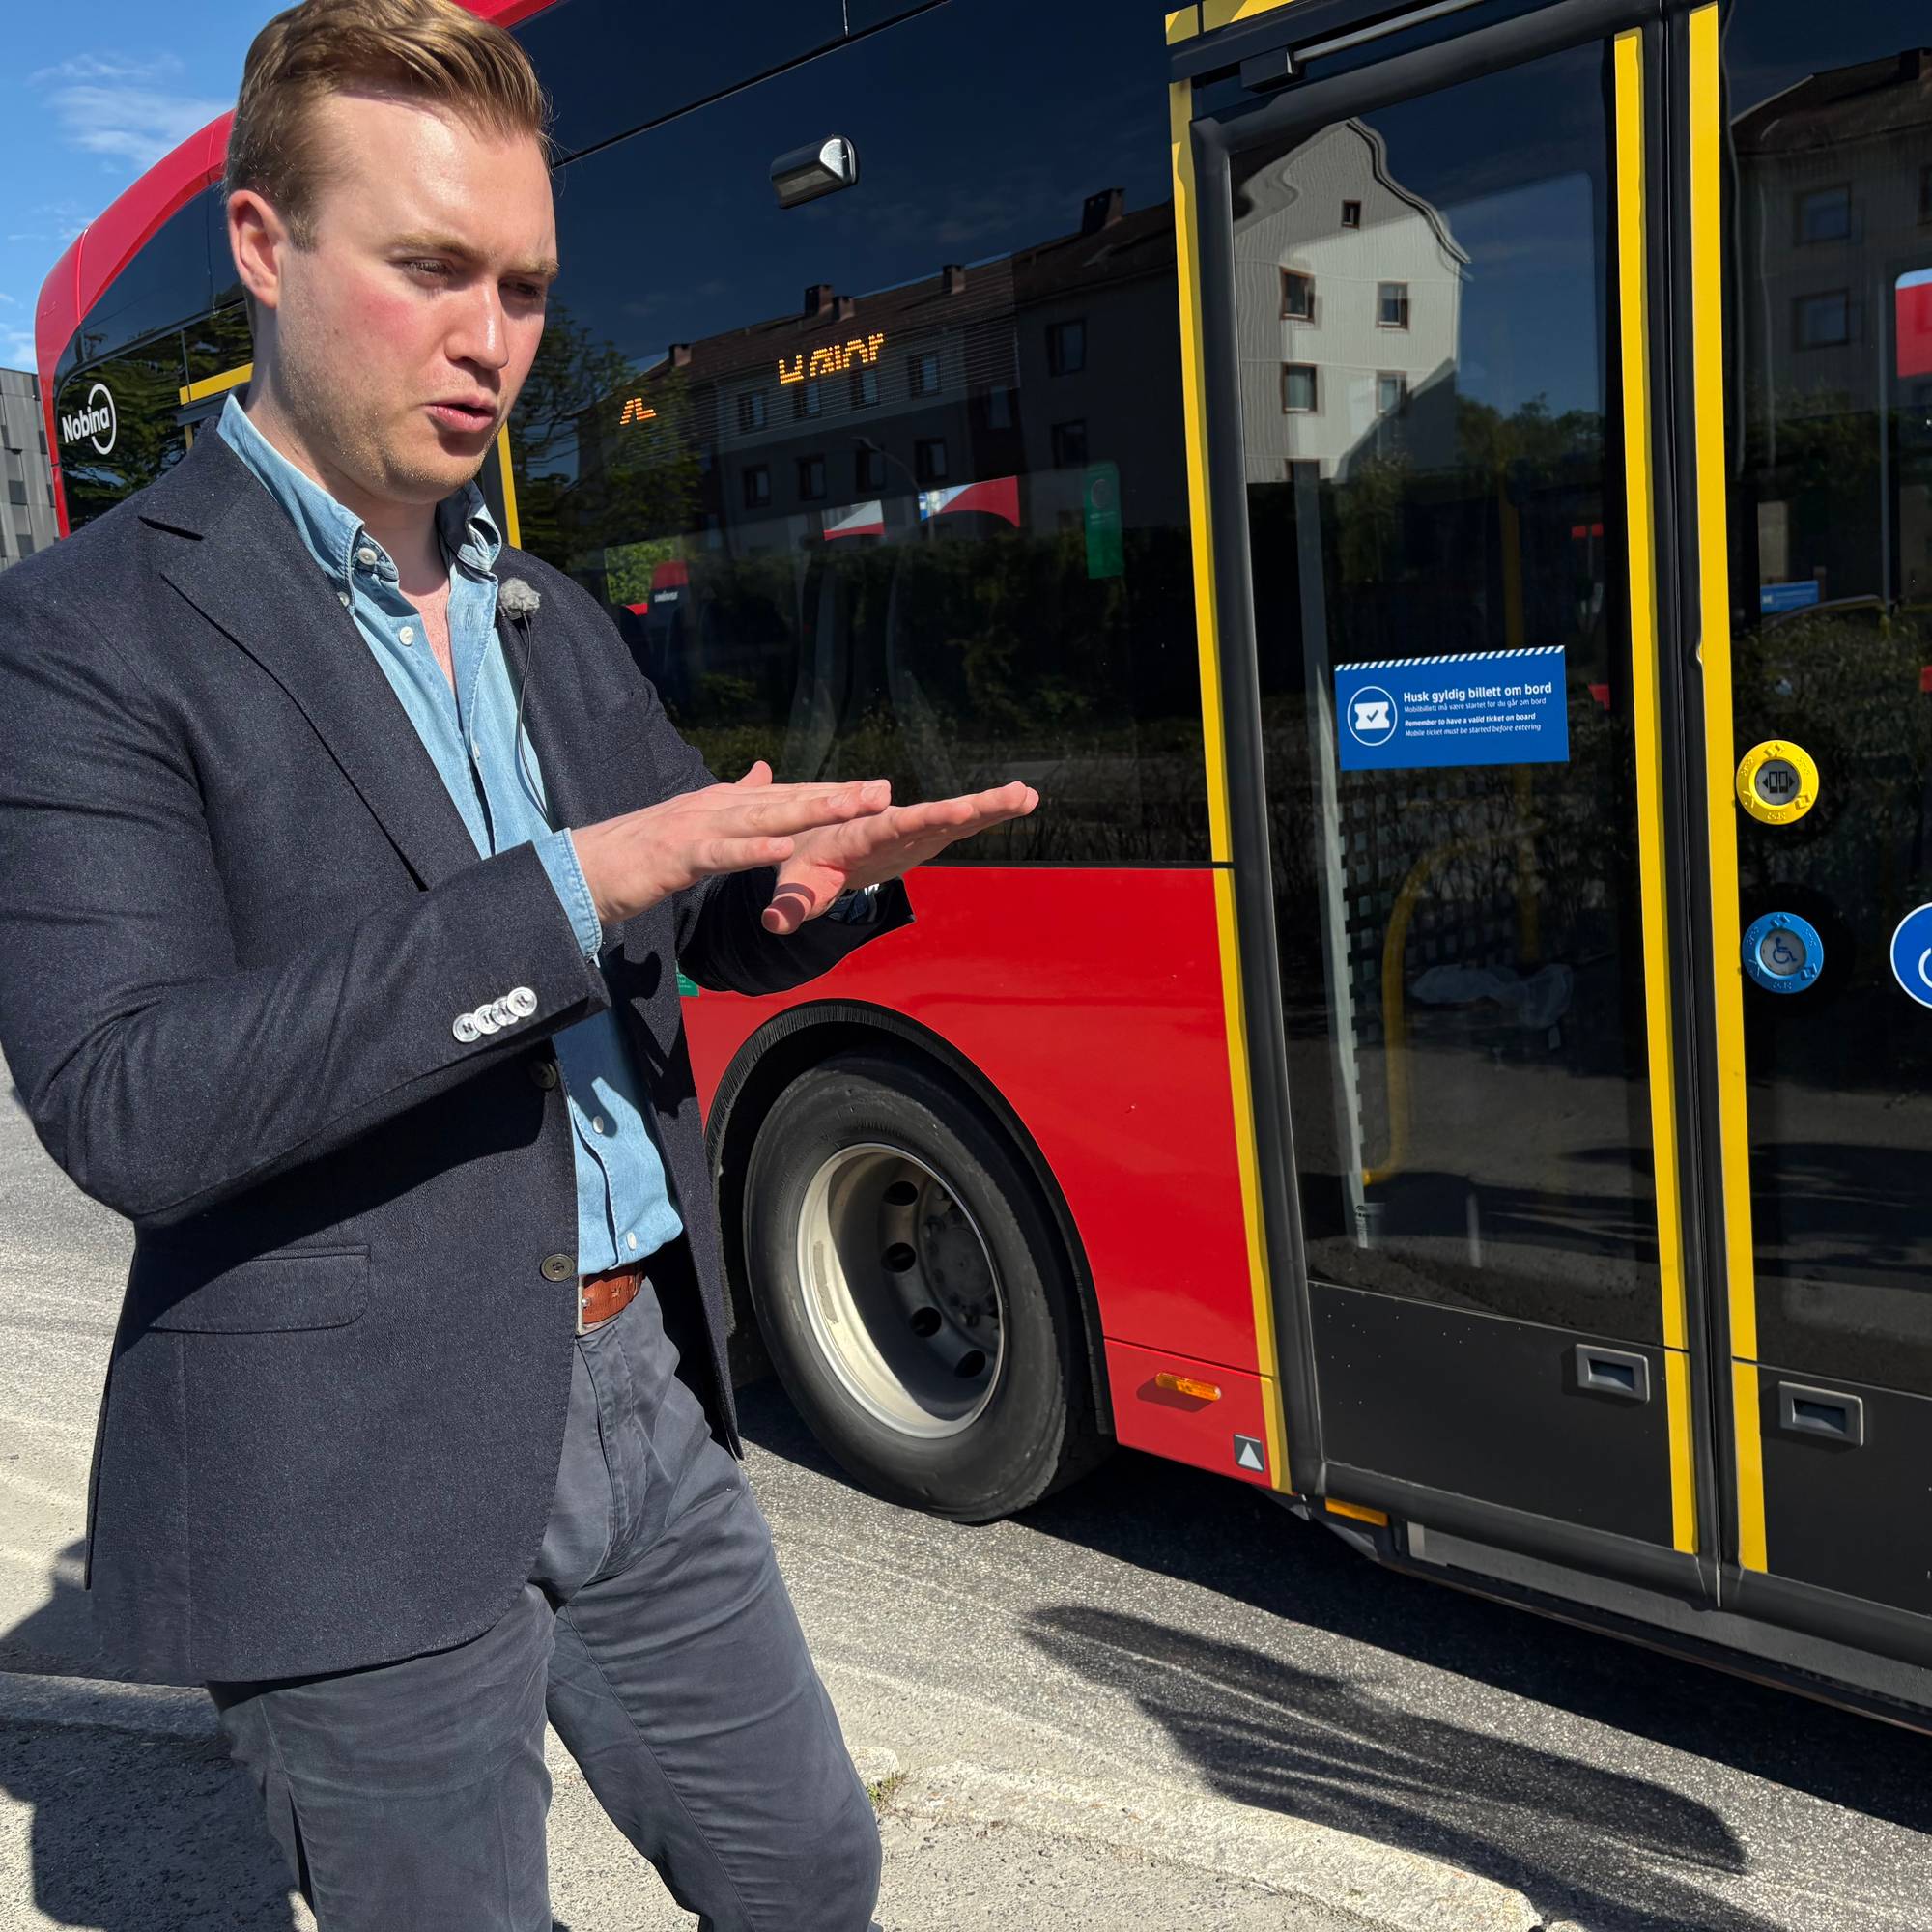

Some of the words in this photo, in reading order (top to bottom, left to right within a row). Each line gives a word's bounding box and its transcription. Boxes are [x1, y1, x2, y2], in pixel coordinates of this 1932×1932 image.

[62, 406, 110, 443] Nobina
[1404, 691, 1429, 703] Husk
[1432, 688, 1465, 703] gyldig
[1468, 686, 1501, 698] billett
[1504, 687, 1521, 696] om
[1524, 681, 1552, 695] bord
[1405, 719, 1437, 727] Remember
[1446, 716, 1462, 724] have
[1468, 715, 1485, 724] valid
[1486, 714, 1504, 723] ticket
[1515, 712, 1536, 721] board
[1426, 727, 1443, 736] ticket
[1469, 724, 1492, 734] started
[1492, 724, 1514, 734] before
[1515, 723, 1542, 732] entering
